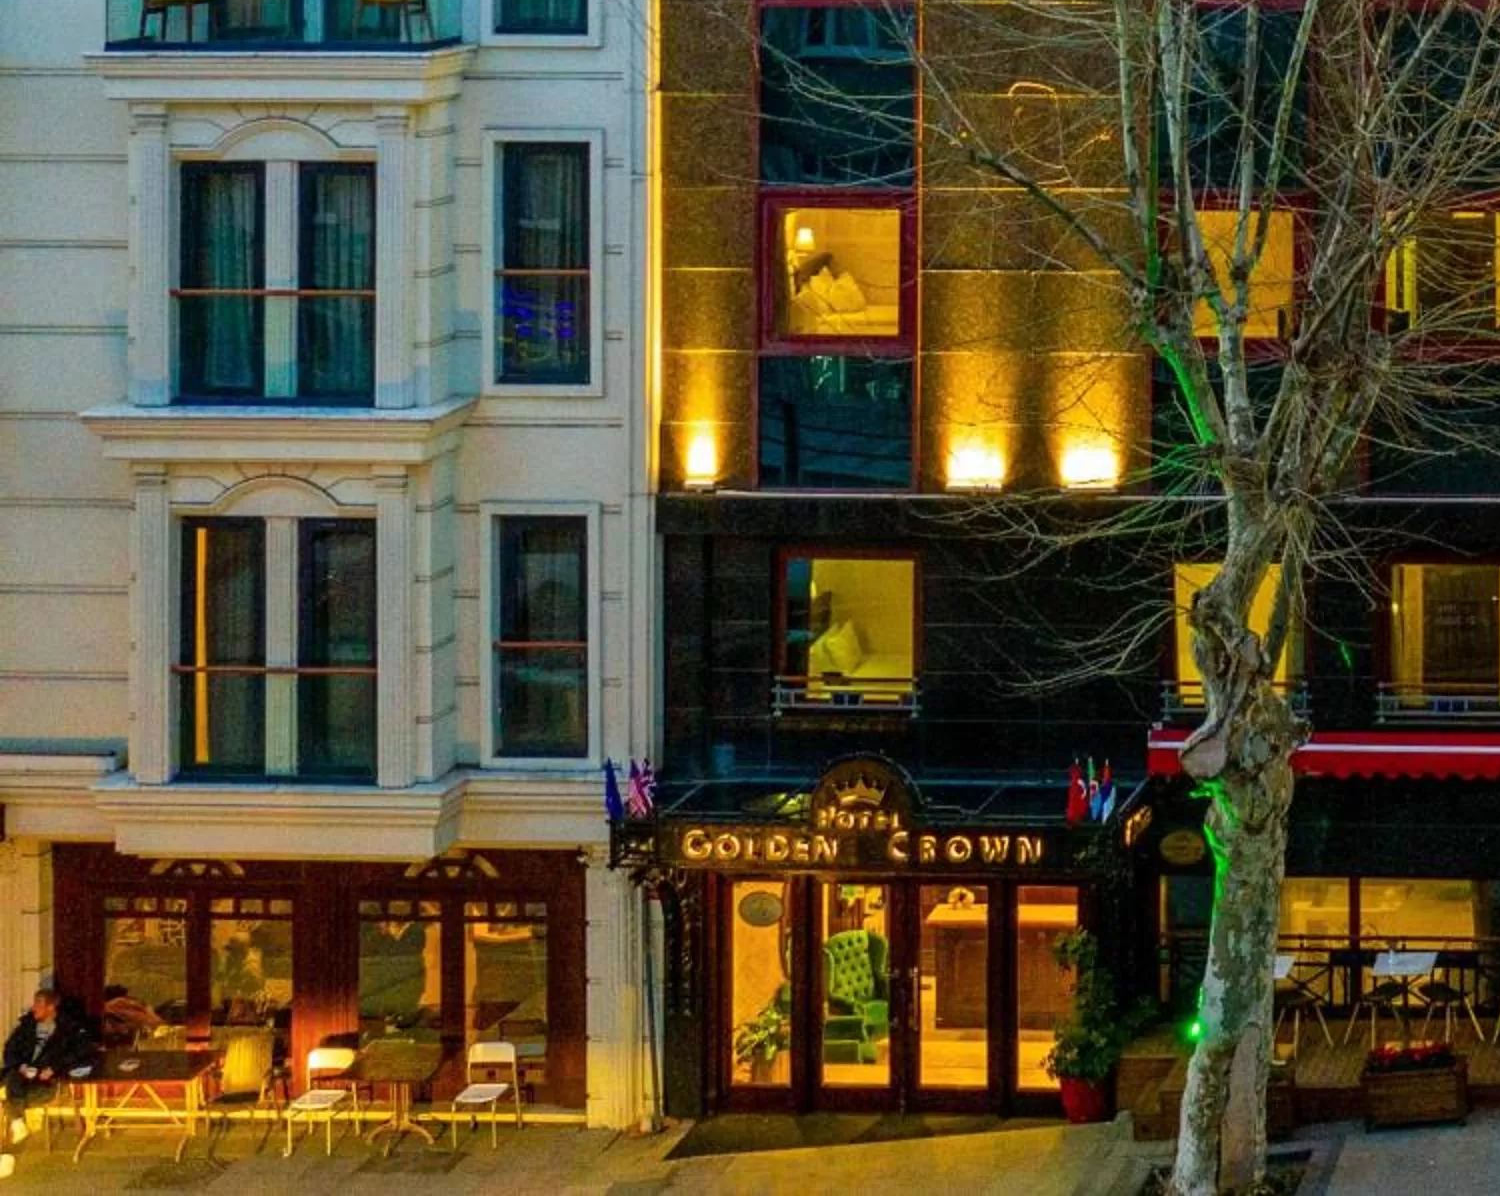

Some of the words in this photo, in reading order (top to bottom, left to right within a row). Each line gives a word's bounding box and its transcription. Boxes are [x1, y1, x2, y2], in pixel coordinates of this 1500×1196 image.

[817, 807, 902, 830] HOTEL
[682, 828, 839, 862] GOLDEN
[886, 830, 1044, 865] CROWN
